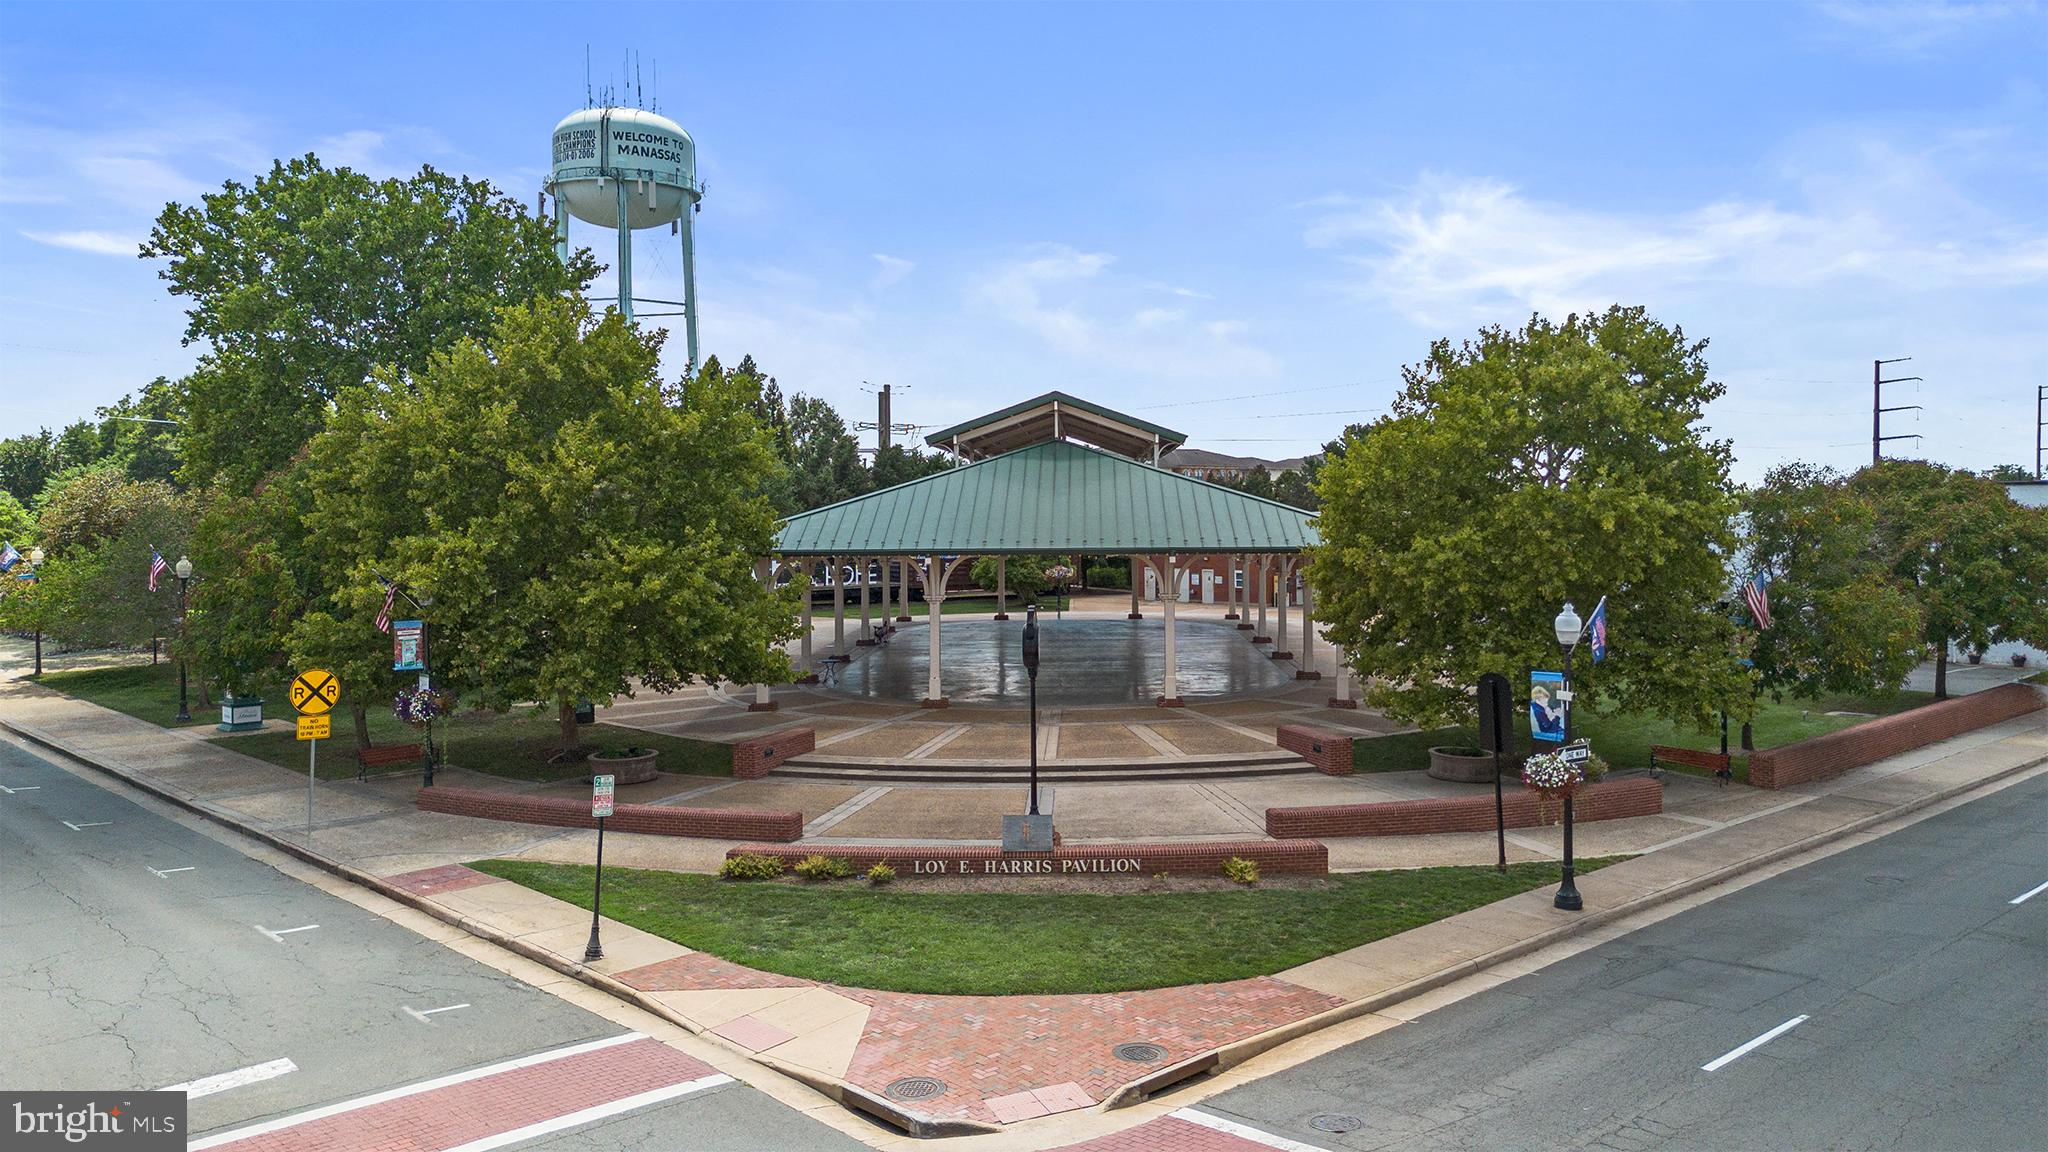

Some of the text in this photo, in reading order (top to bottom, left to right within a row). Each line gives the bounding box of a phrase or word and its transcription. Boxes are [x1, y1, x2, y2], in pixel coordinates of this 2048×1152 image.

[573, 130, 596, 140] SCHOOL
[613, 131, 683, 150] WELCOME TO
[563, 139, 595, 150] CHAMPIONS
[579, 150, 594, 159] 2006
[618, 145, 680, 163] MANASSAS
[294, 685, 336, 699] R R
[914, 859, 1141, 874] LOY E. HARRIS PAVILION
